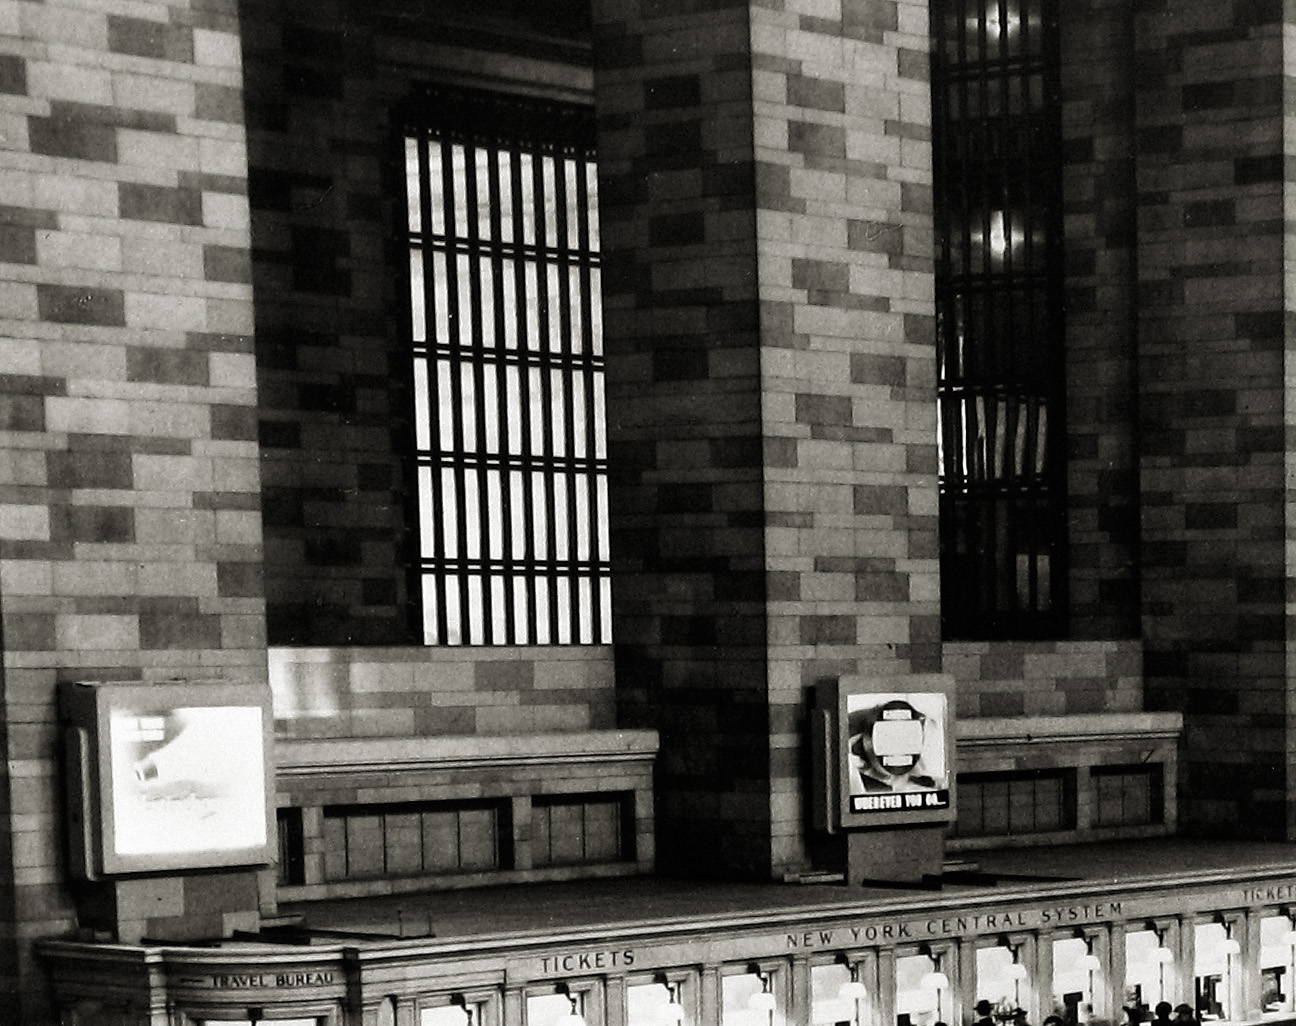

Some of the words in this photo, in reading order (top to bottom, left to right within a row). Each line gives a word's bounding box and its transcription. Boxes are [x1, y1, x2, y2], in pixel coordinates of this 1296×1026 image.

[787, 932, 833, 948] NEW
[851, 924, 912, 943] YORK
[926, 912, 1026, 935] CENTRAL
[1041, 902, 1123, 922] SYSTEM
[541, 950, 636, 974] TICKETS
[212, 973, 268, 988] TRAVEL
[276, 972, 334, 986] BUREAU
